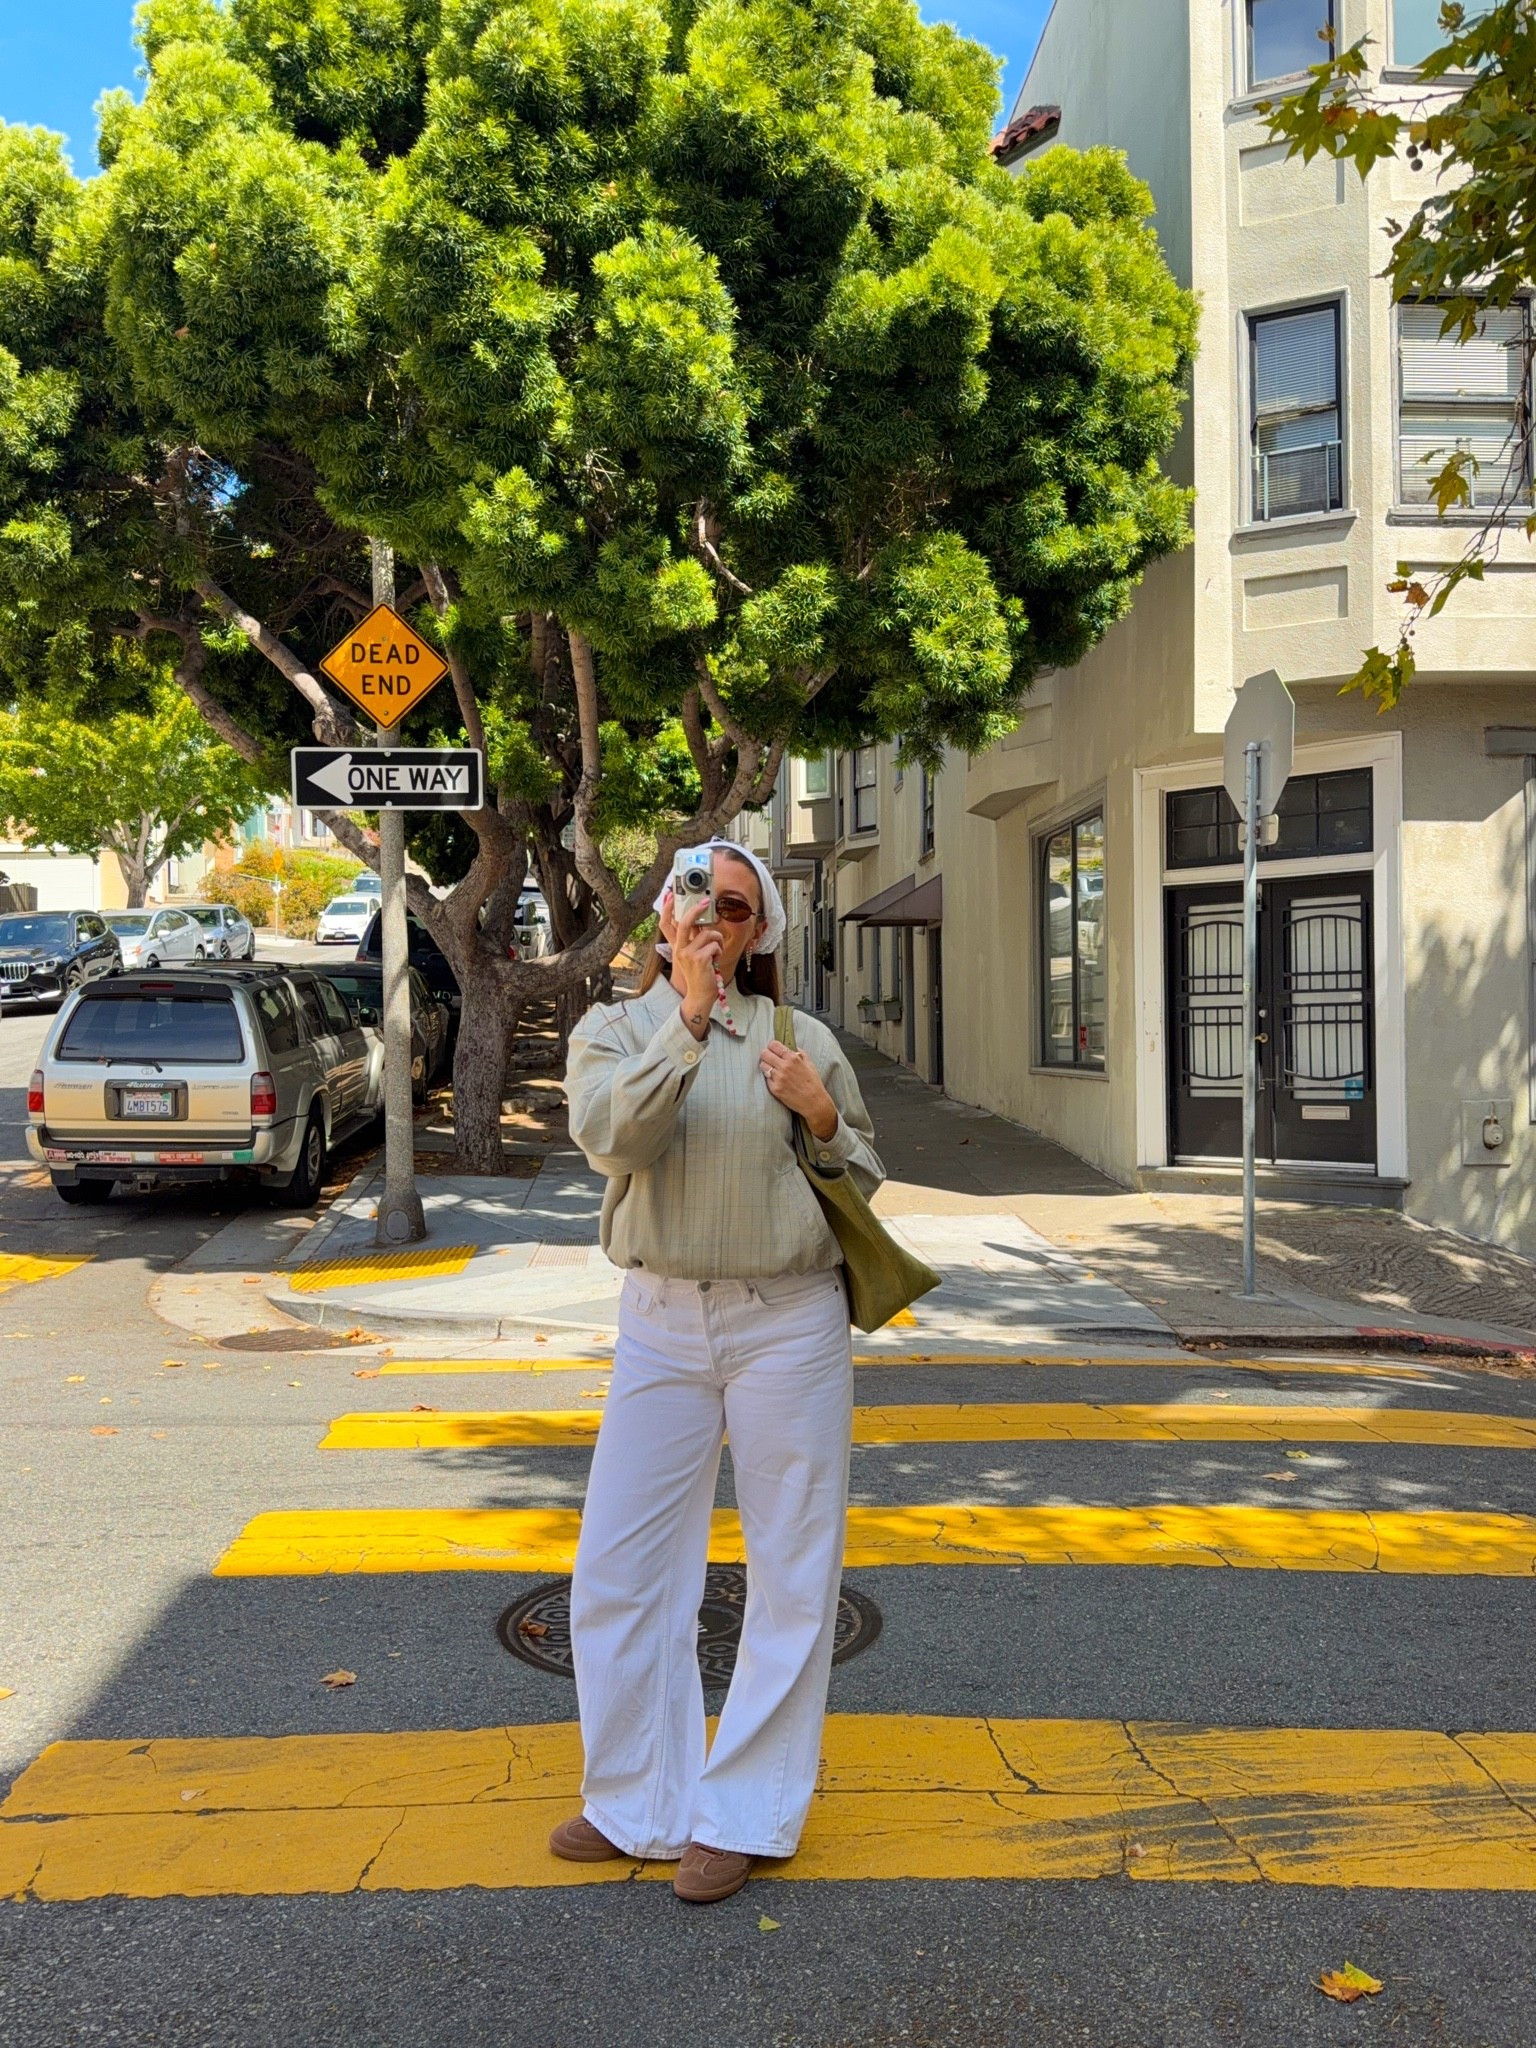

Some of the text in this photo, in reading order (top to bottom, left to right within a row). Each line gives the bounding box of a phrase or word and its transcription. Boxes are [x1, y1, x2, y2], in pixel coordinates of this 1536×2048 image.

[351, 642, 420, 665] DEAD
[361, 674, 411, 696] END
[347, 766, 463, 791] ONE WAY
[127, 1100, 169, 1112] 4MBT575
